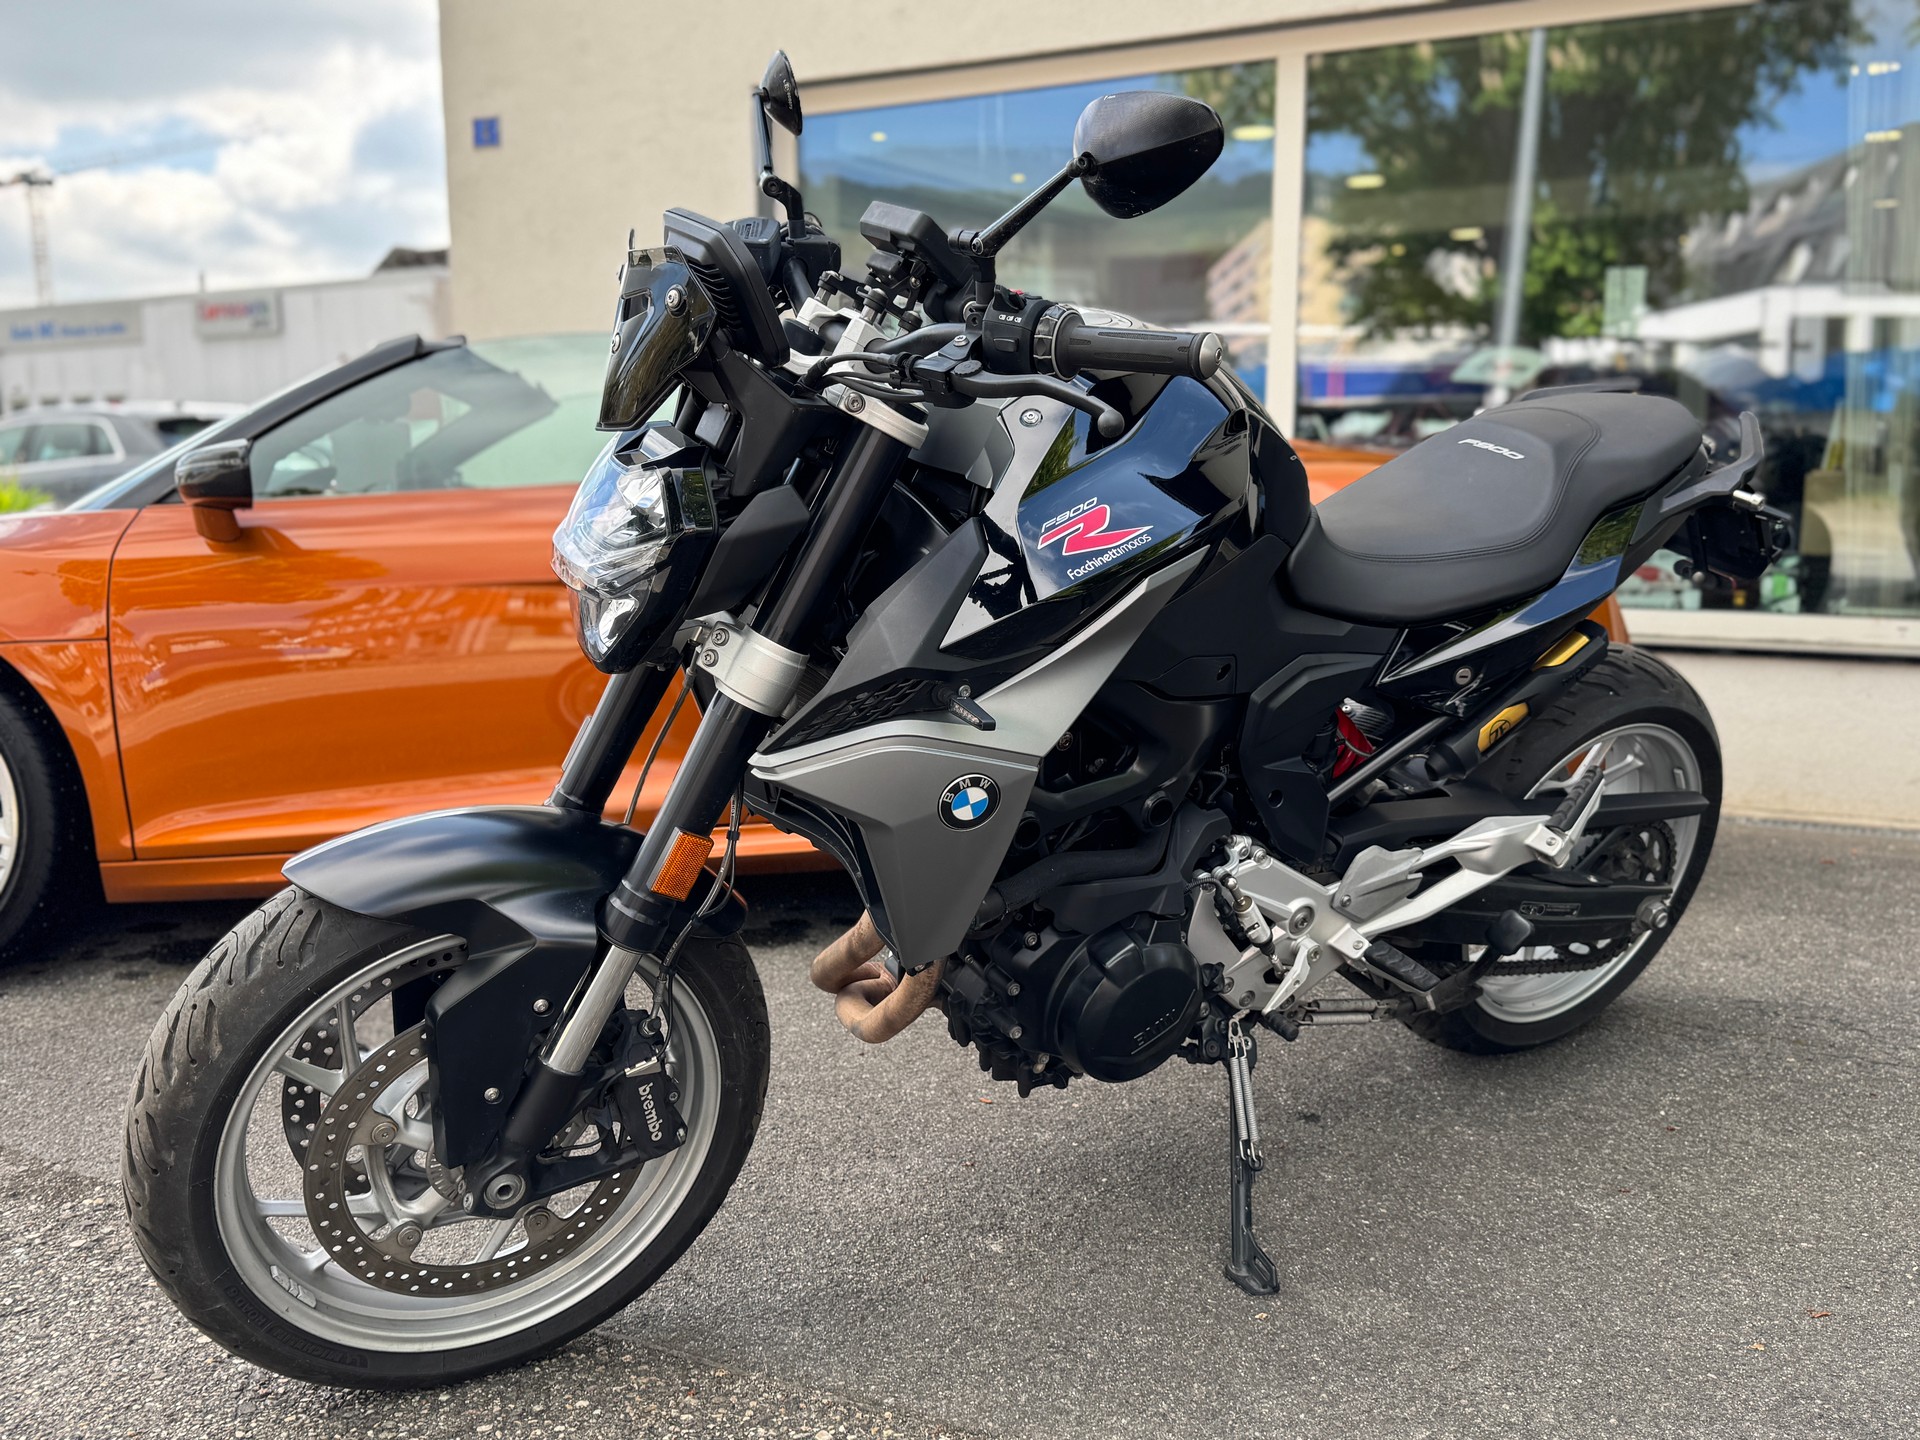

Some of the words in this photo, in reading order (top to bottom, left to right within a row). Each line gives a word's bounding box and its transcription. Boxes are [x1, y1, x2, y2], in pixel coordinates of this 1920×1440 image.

[1458, 438, 1525, 460] F900
[1037, 503, 1154, 556] R
[1041, 496, 1098, 533] F900
[942, 778, 991, 803] BMW
[638, 1082, 663, 1142] brembo
